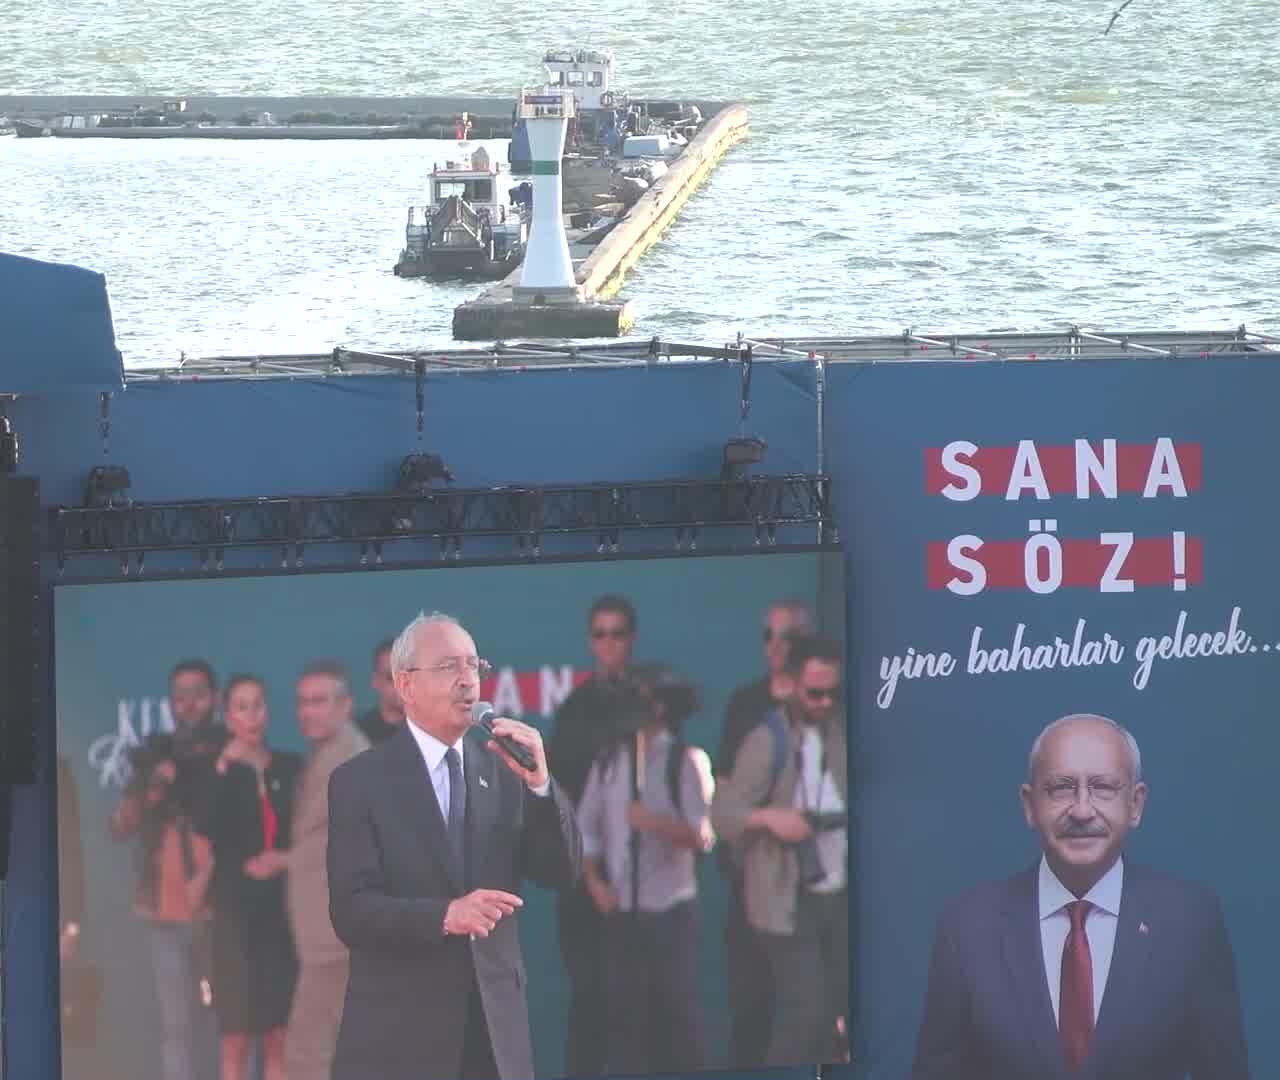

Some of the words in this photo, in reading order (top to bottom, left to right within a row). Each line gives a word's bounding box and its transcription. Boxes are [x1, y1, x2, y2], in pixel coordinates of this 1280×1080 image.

[941, 437, 1188, 501] SANA
[947, 519, 1187, 596] SÖZ!
[492, 665, 574, 717] AN
[877, 648, 957, 710] yine
[967, 618, 1125, 674] baharlar
